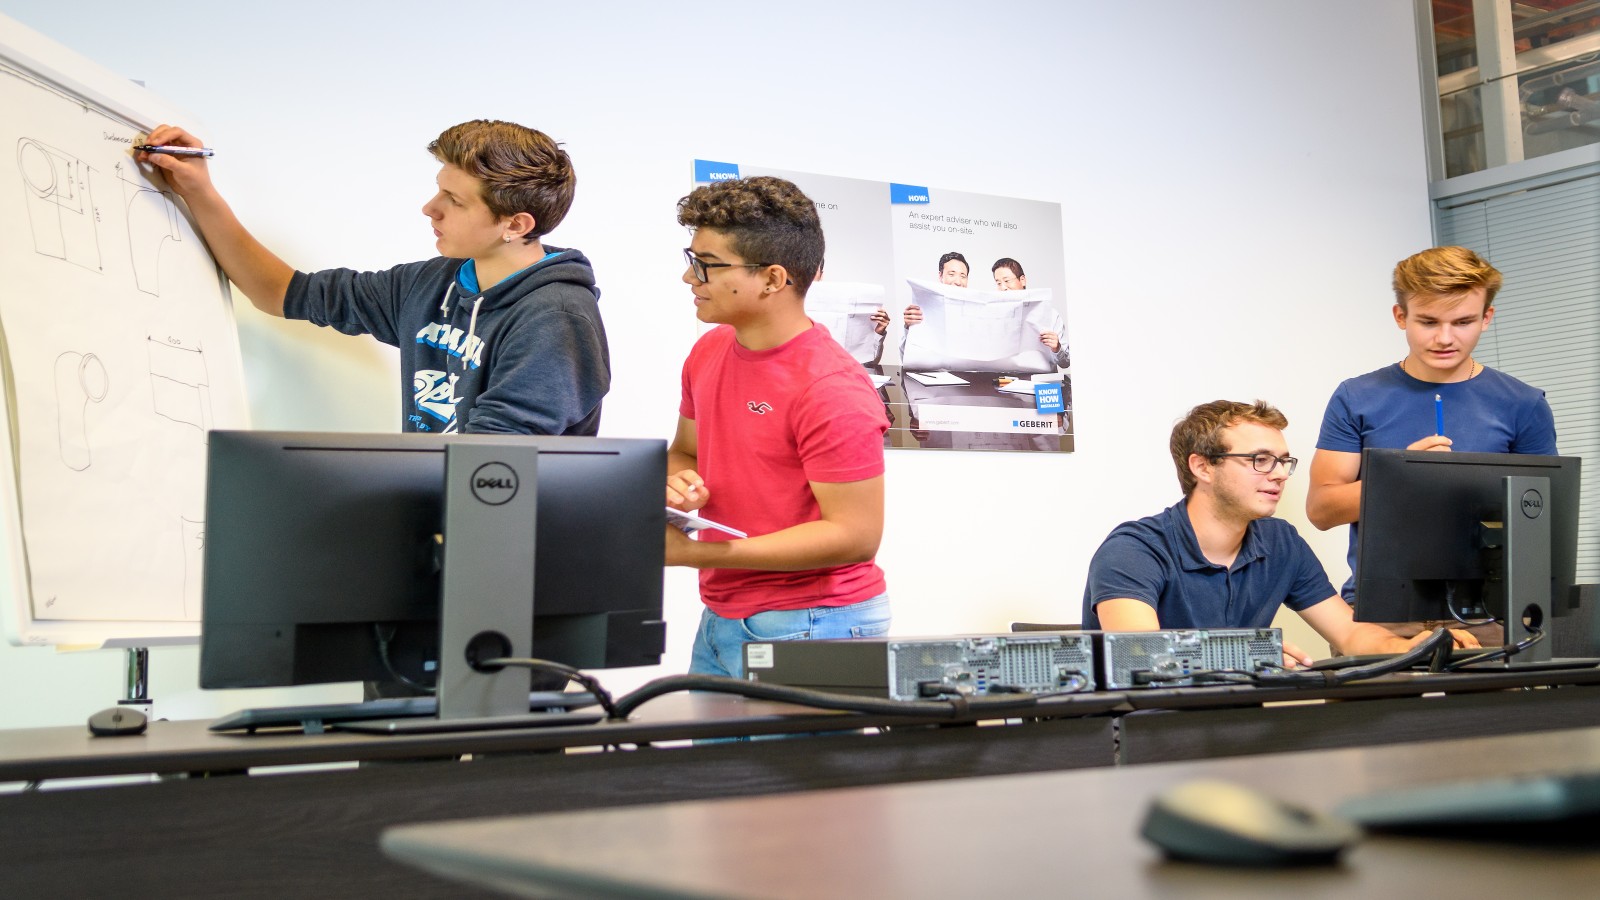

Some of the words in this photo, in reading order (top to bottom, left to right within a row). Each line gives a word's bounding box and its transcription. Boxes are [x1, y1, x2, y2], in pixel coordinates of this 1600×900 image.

[709, 172, 738, 180] KNOW:
[908, 194, 928, 202] HOW:
[909, 211, 919, 219] An
[921, 213, 944, 222] expert
[946, 216, 971, 225] adviser
[974, 219, 989, 227] who
[990, 220, 1001, 228] will
[1003, 222, 1018, 230] also
[909, 222, 931, 231] assist
[932, 225, 946, 233] you
[947, 226, 975, 235] on-site.
[1038, 388, 1058, 396] KNOW
[1039, 395, 1059, 404] HOW
[1020, 420, 1053, 428] GEBERIT
[476, 478, 513, 489] DELL
[1523, 500, 1541, 508] DELL
